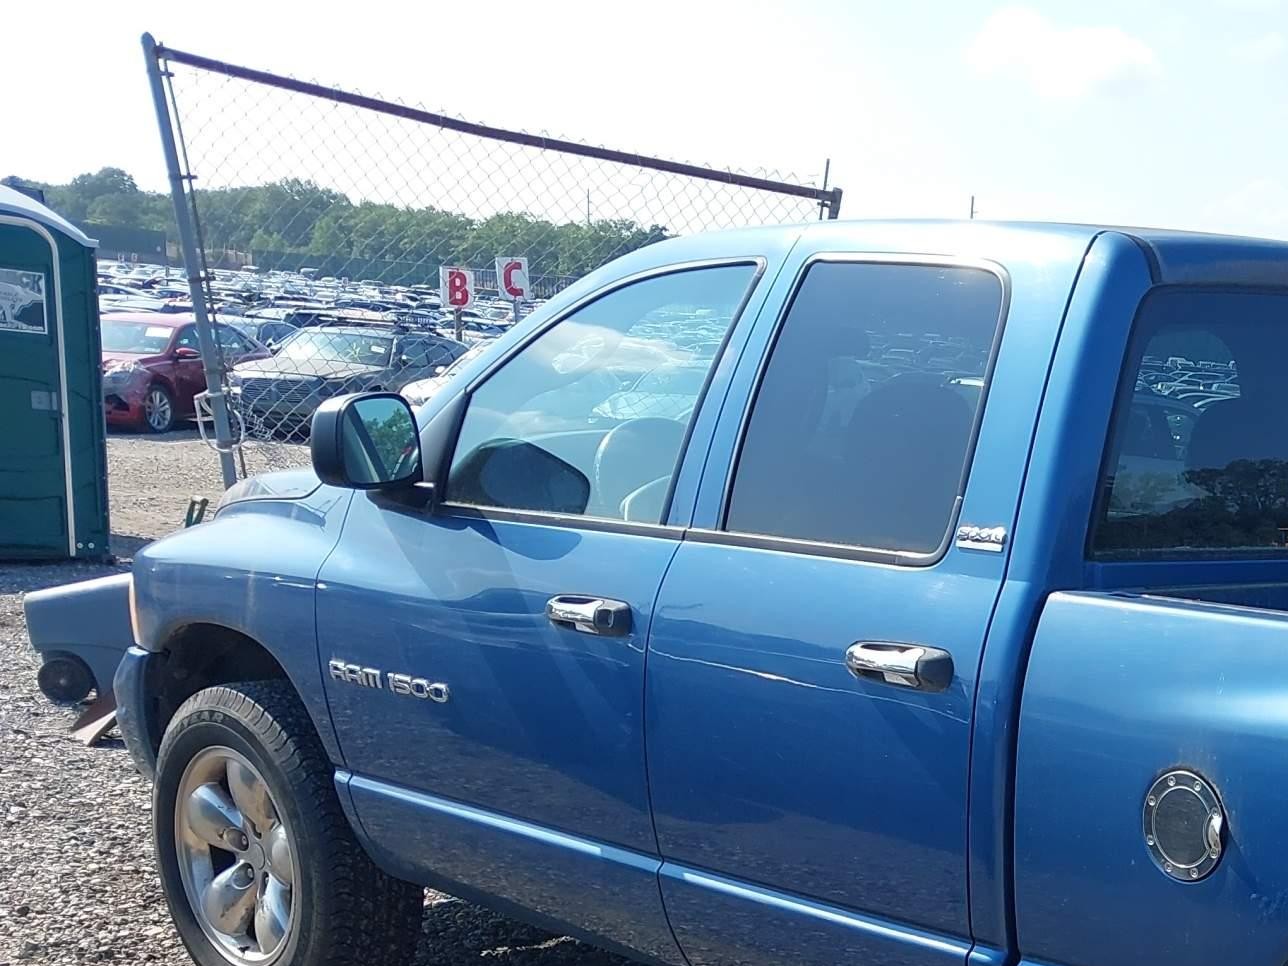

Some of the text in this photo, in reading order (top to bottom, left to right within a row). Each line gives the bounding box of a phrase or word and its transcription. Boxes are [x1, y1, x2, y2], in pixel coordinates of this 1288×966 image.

[448, 270, 468, 305] B
[503, 261, 524, 297] C
[328, 660, 449, 703] RAM 1500
